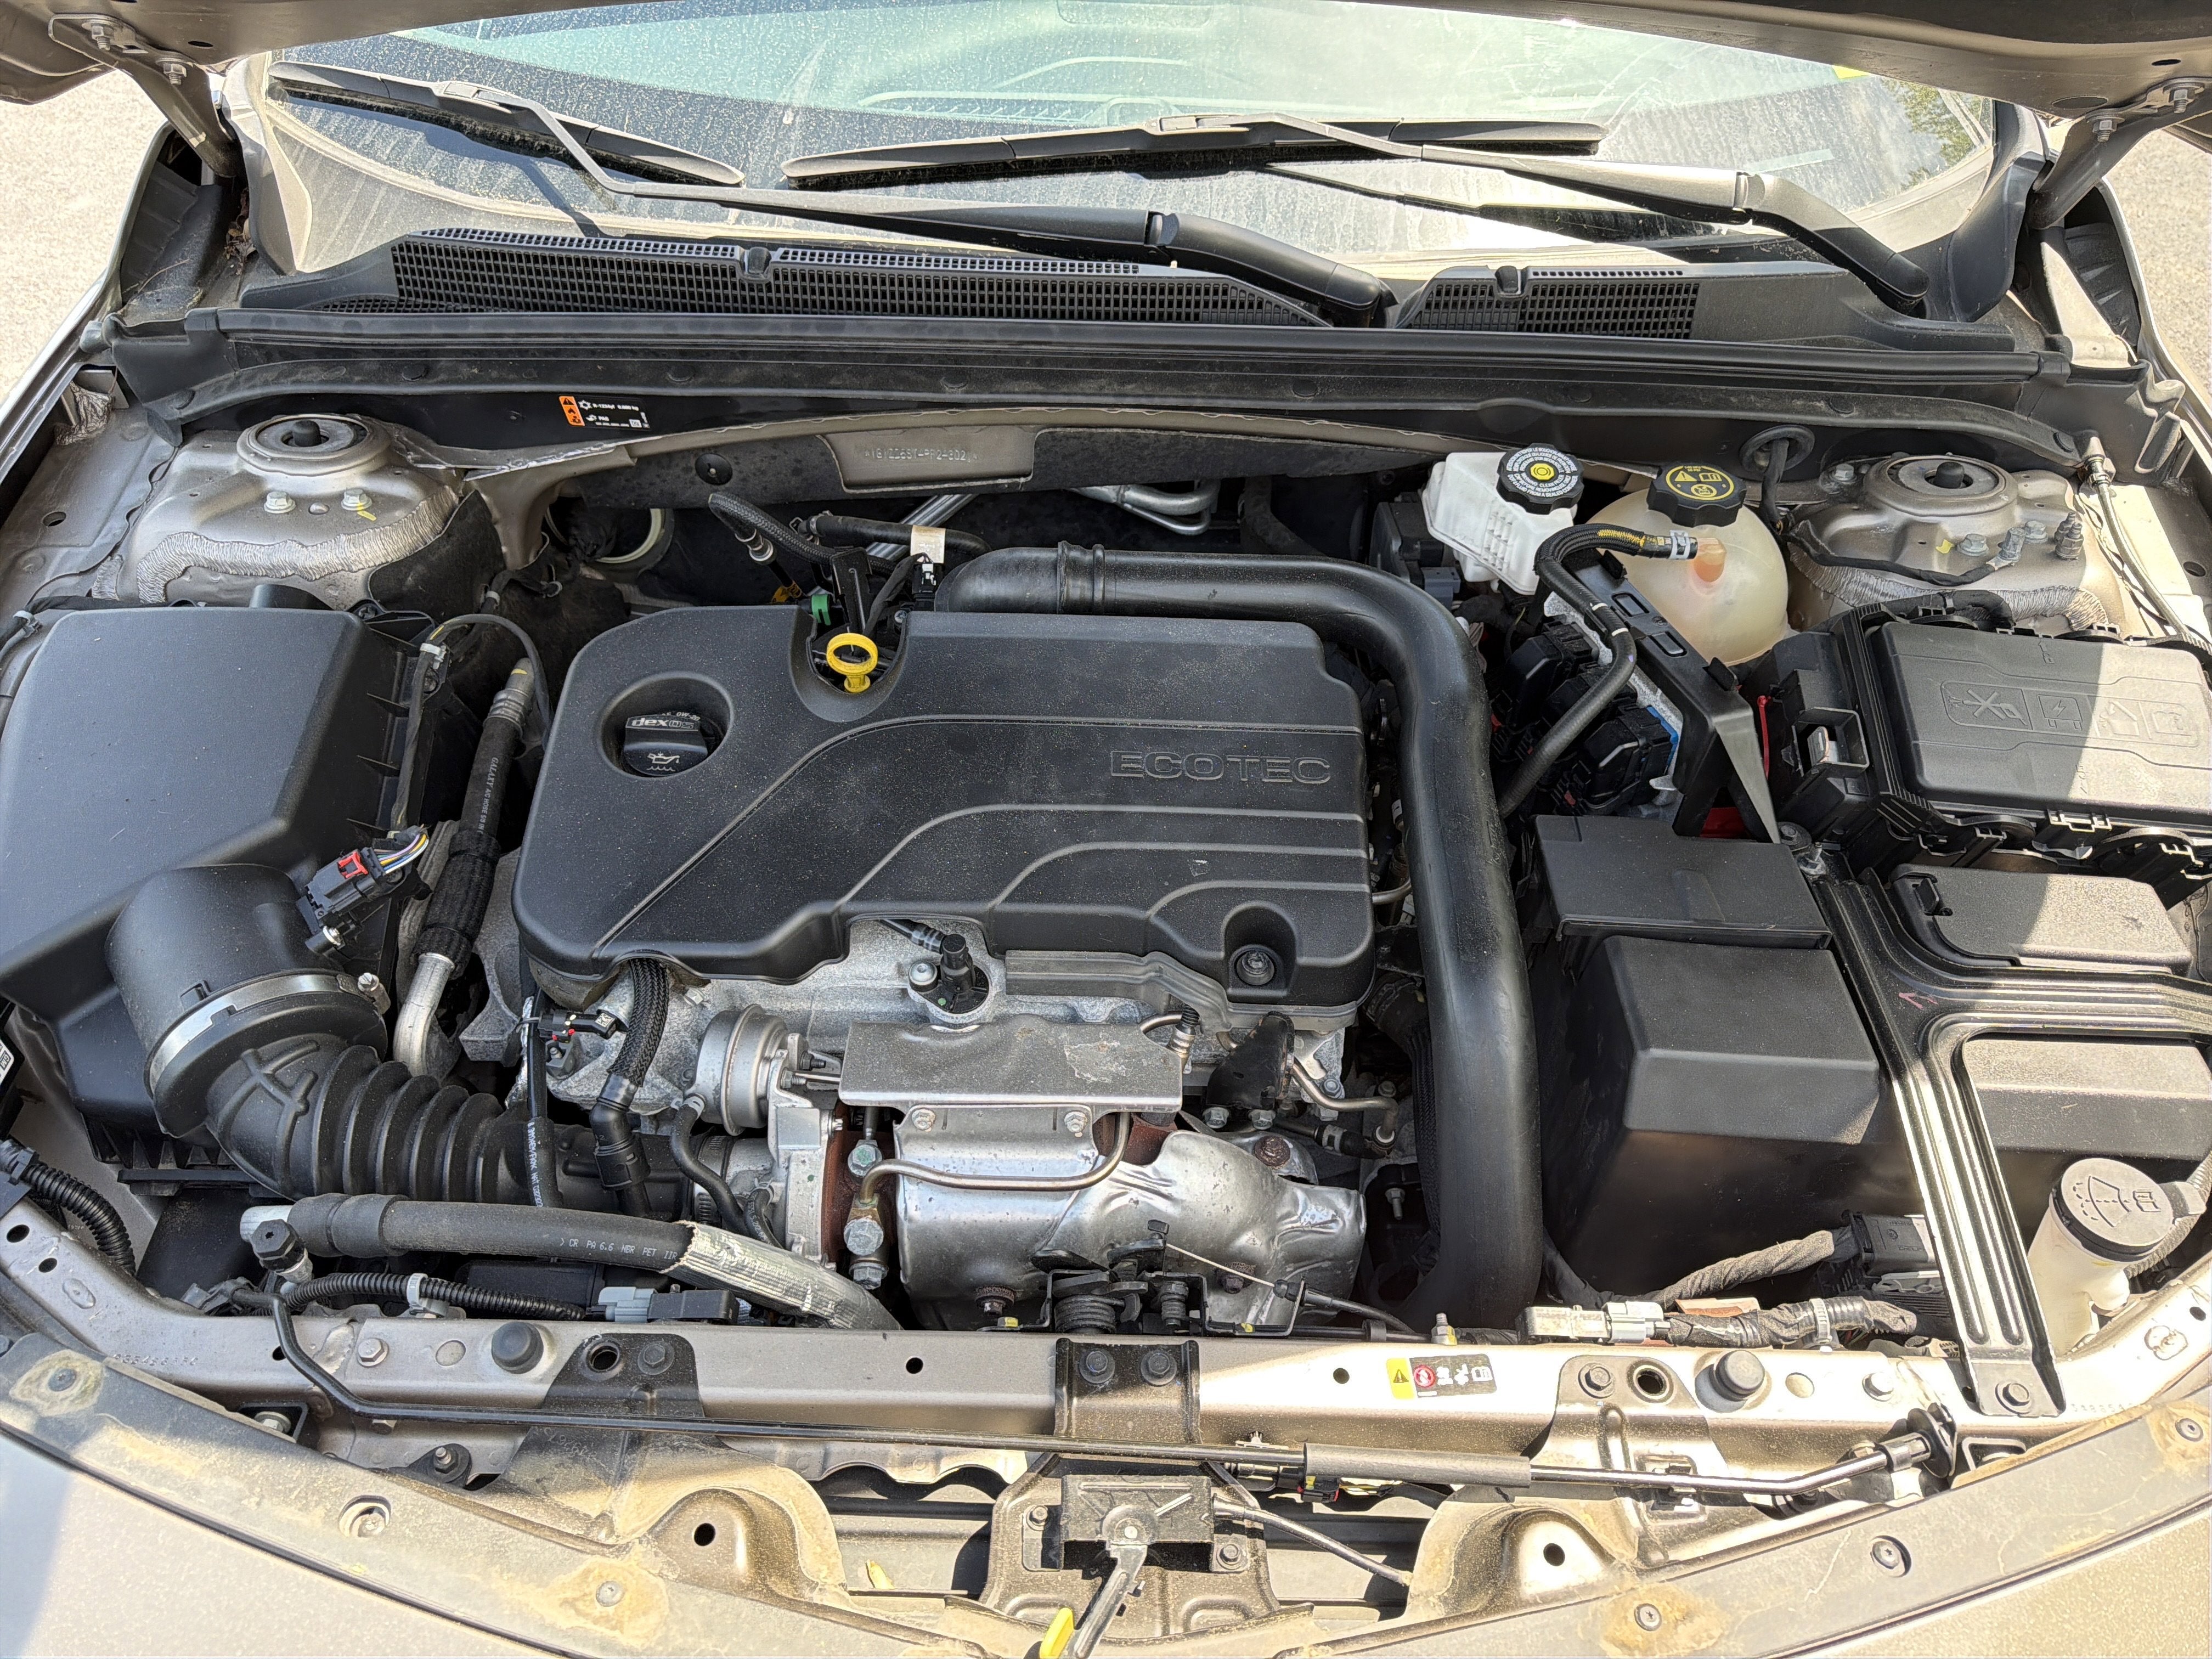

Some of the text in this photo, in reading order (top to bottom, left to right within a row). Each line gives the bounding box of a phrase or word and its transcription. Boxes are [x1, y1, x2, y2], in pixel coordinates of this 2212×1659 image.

[1110, 751, 1331, 784] ECOTEC
[482, 798, 490, 814] HOSE
[569, 1238, 579, 1248] CR
[586, 1240, 596, 1249] PA
[600, 1242, 614, 1251] 6.6
[621, 1244, 635, 1254] NBR
[642, 1247, 657, 1257] PET
